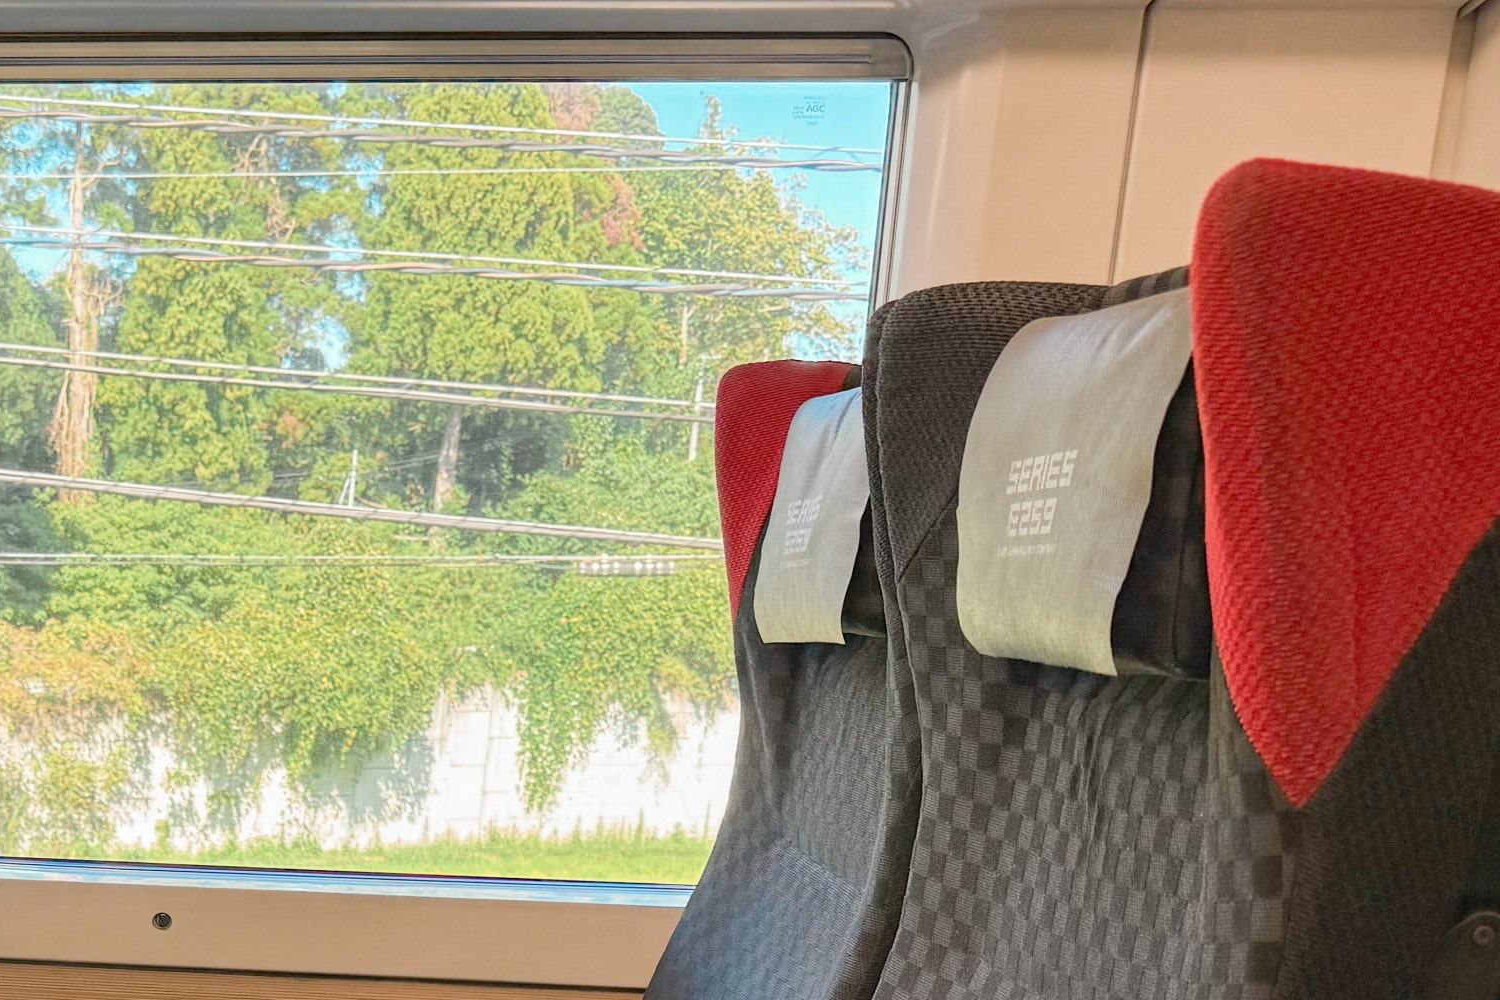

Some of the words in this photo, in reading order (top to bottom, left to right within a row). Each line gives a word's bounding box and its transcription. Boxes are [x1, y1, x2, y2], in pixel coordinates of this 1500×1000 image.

[806, 104, 825, 113] AGC
[1006, 450, 1079, 495] SERIES
[786, 494, 823, 525] SERIES
[1007, 498, 1058, 537] E259
[784, 528, 812, 554] E259
